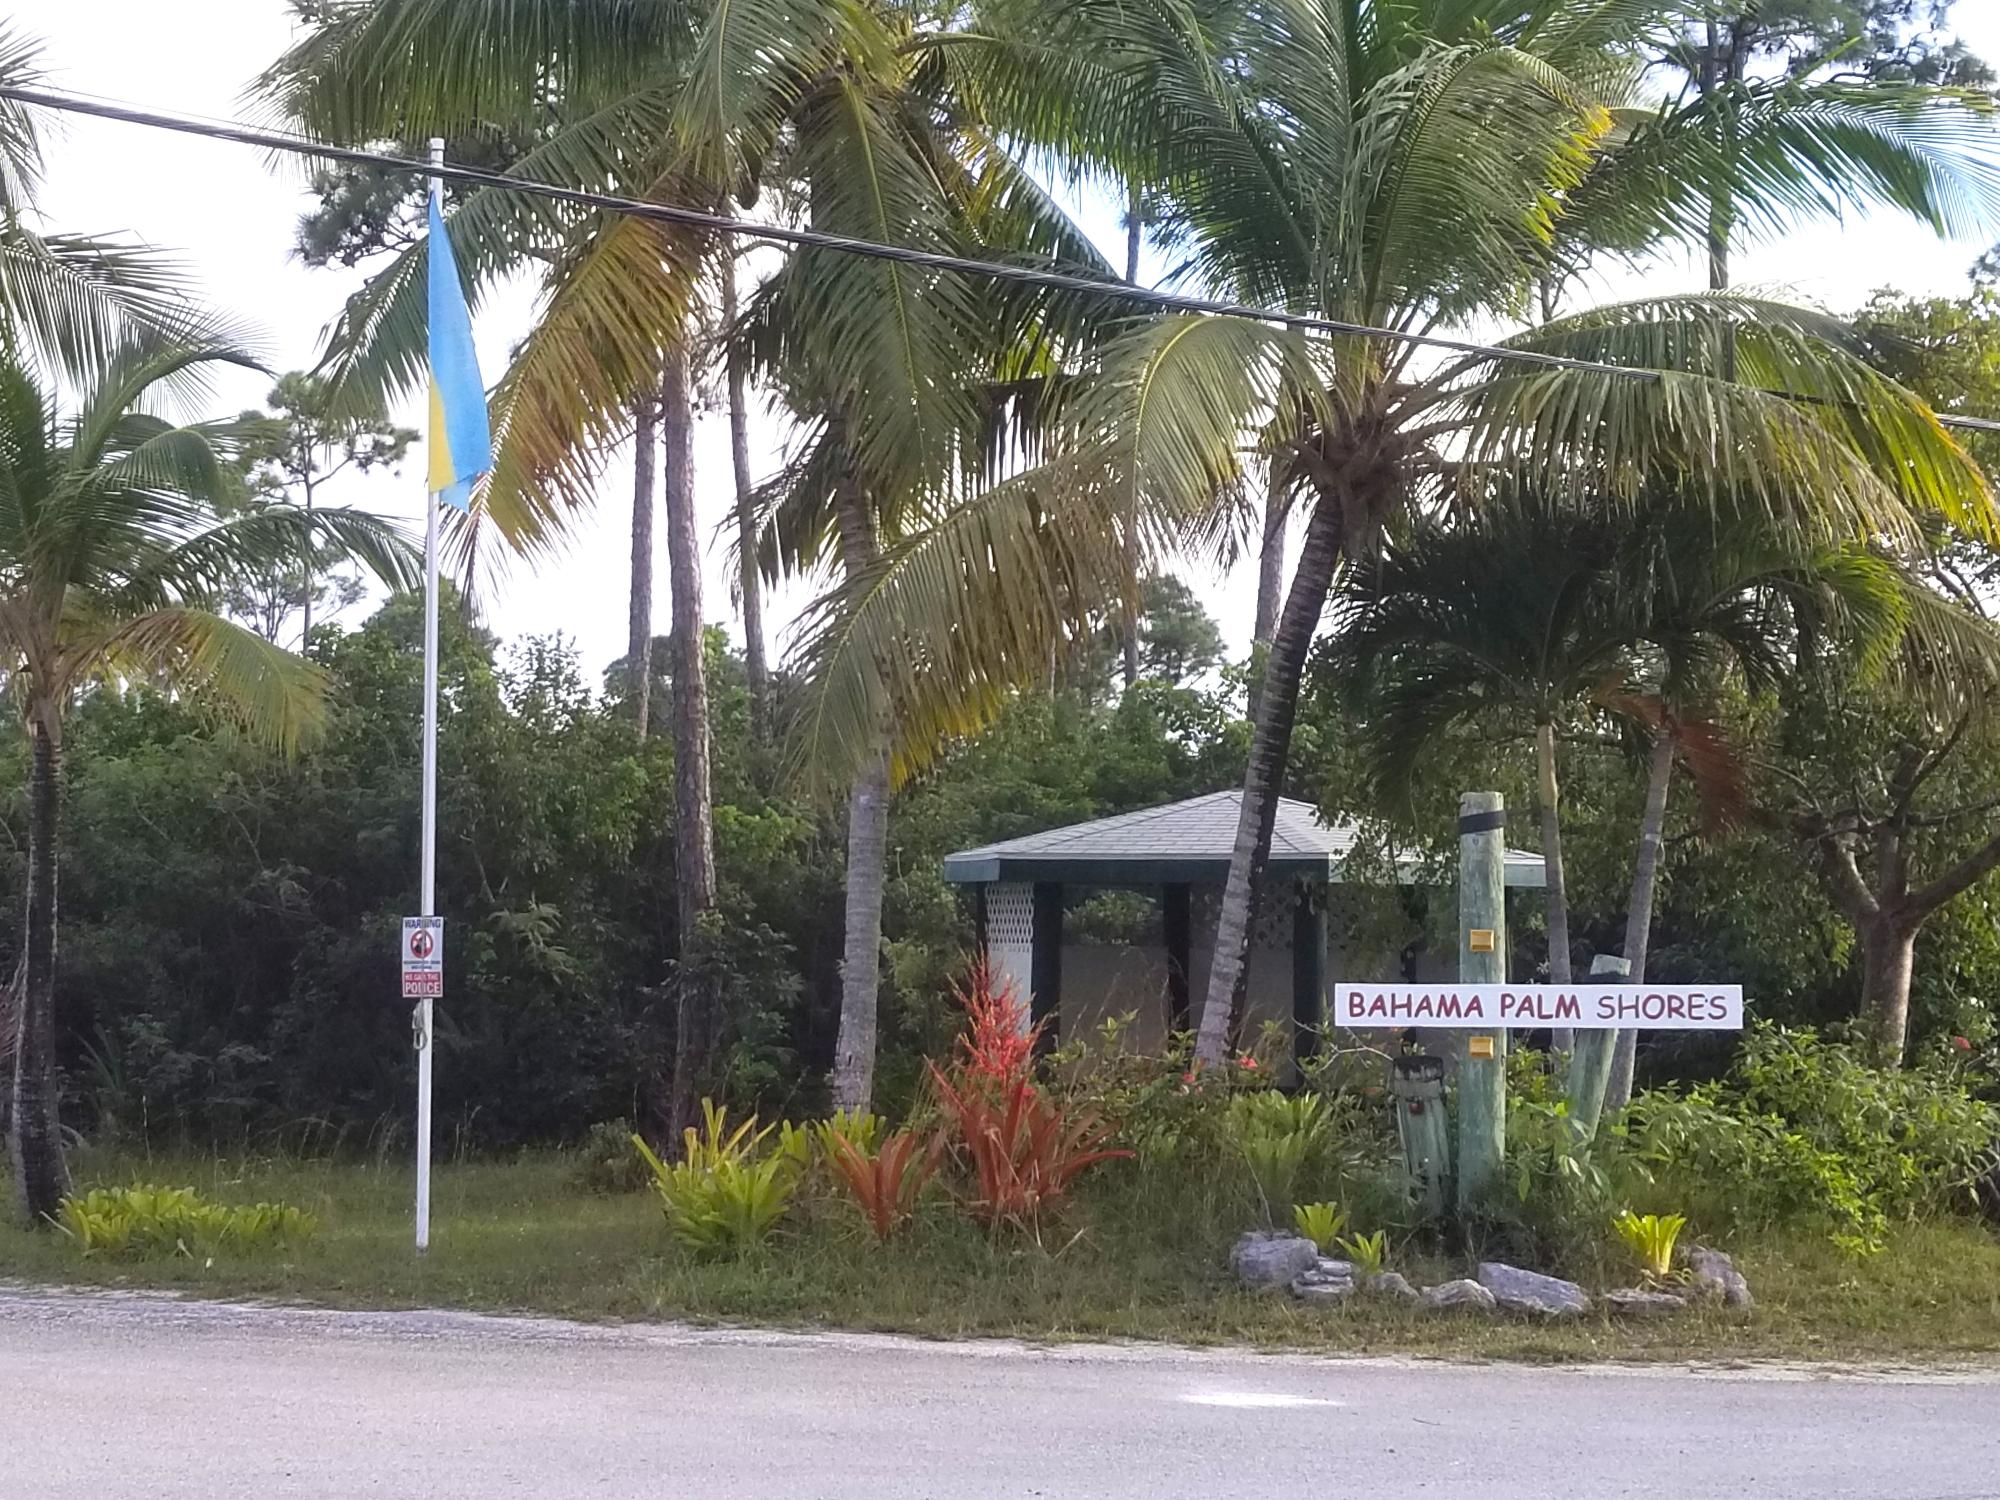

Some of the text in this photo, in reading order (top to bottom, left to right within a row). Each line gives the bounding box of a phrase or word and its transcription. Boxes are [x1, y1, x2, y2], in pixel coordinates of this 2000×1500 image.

[405, 919, 441, 928] WARING
[405, 981, 440, 993] POLICE
[1348, 992, 1483, 1019] BAHAMA
[1500, 993, 1581, 1020] PALM
